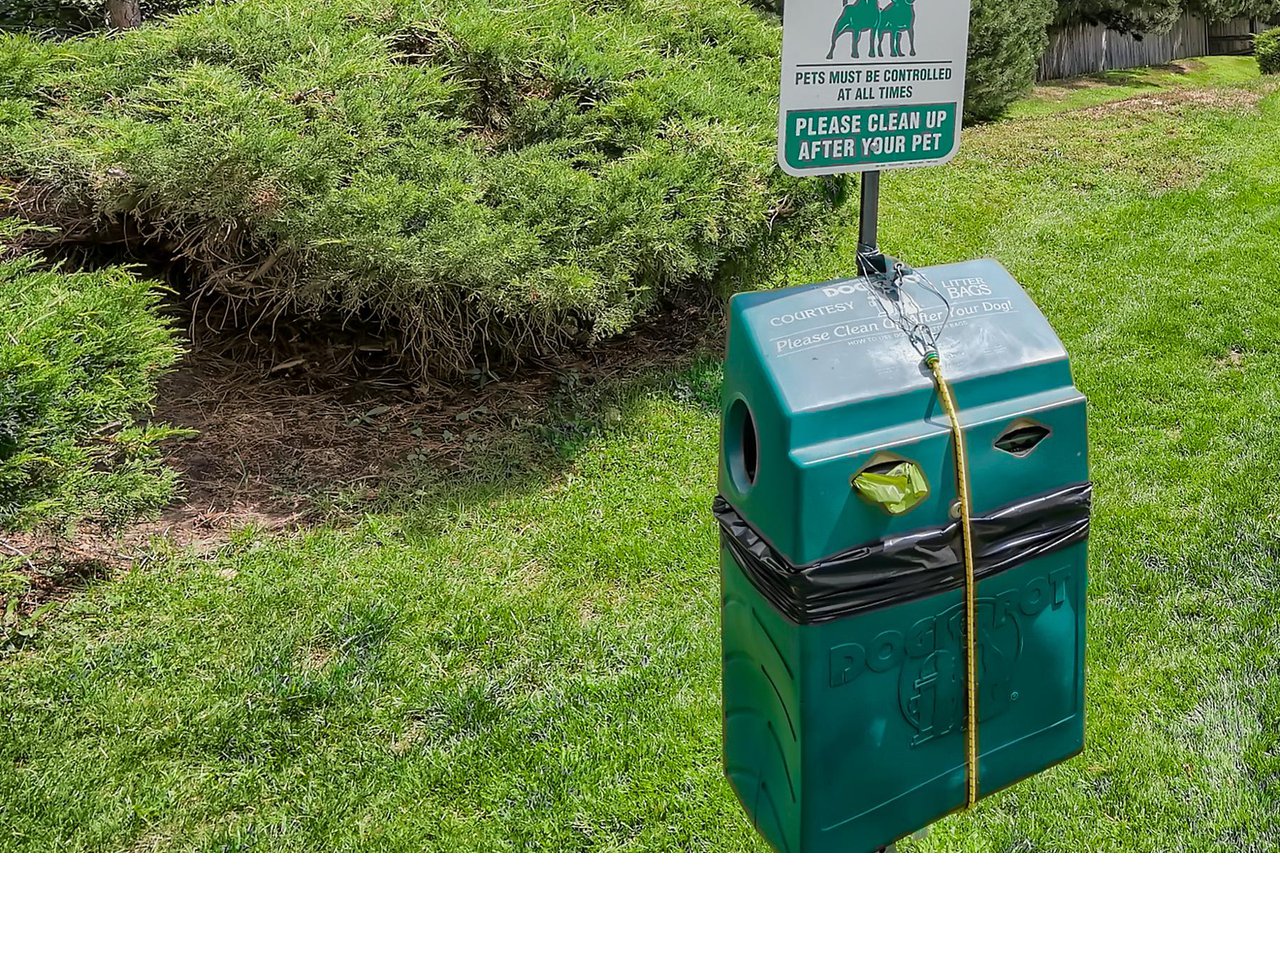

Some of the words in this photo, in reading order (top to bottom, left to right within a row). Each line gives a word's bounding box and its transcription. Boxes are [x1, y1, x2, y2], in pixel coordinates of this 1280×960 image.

[795, 71, 826, 85] PETS
[829, 70, 862, 84] MUST
[866, 70, 880, 83] BE
[884, 68, 952, 82] CONTROLLED
[837, 88, 851, 101] AT
[855, 87, 875, 100] ALL
[879, 86, 913, 99] TIMES
[795, 114, 862, 137] PLEASE
[868, 111, 920, 132] CLEAN
[926, 110, 948, 129] UP
[798, 139, 855, 161] AFTER
[862, 135, 906, 156] YOUR
[912, 133, 943, 152] PET
[941, 277, 985, 288] LITTER
[947, 284, 992, 299] BAGS
[769, 301, 855, 327] COURTESY
[776, 331, 831, 353] Please
[833, 322, 879, 337] Clean
[946, 304, 979, 318] Your
[982, 300, 1014, 312] Dog!
